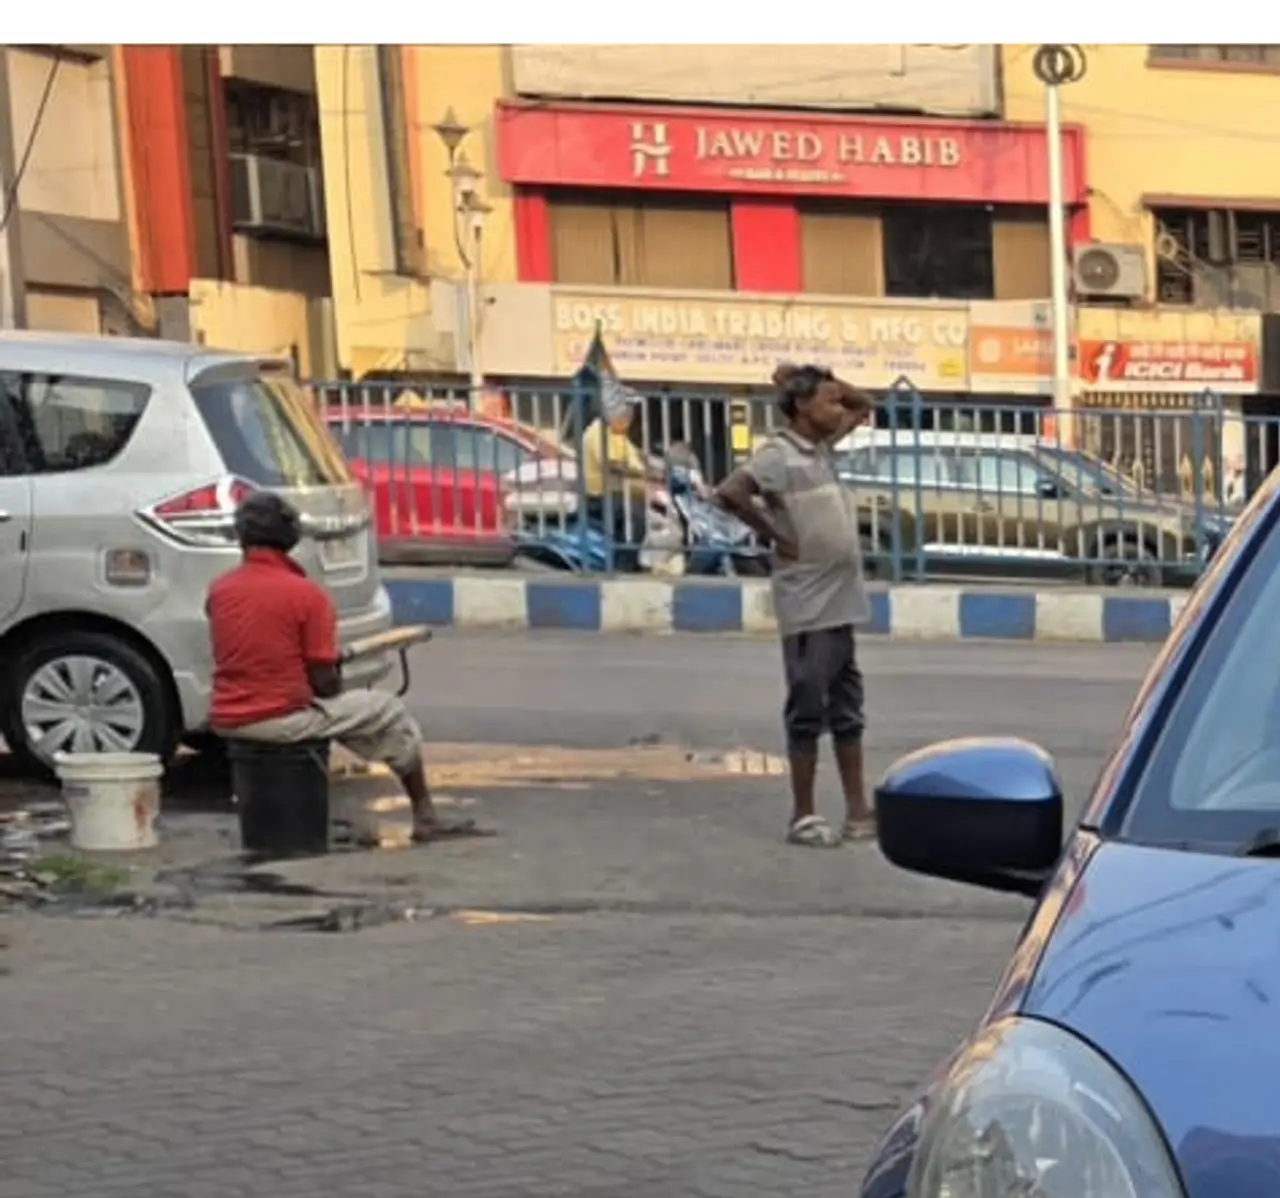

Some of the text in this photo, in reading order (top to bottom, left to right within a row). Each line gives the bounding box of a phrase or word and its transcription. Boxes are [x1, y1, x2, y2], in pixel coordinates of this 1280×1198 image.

[695, 126, 962, 167] JAWED HABIB
[556, 303, 966, 345] BOSS INDIA TRADING & MFG CO
